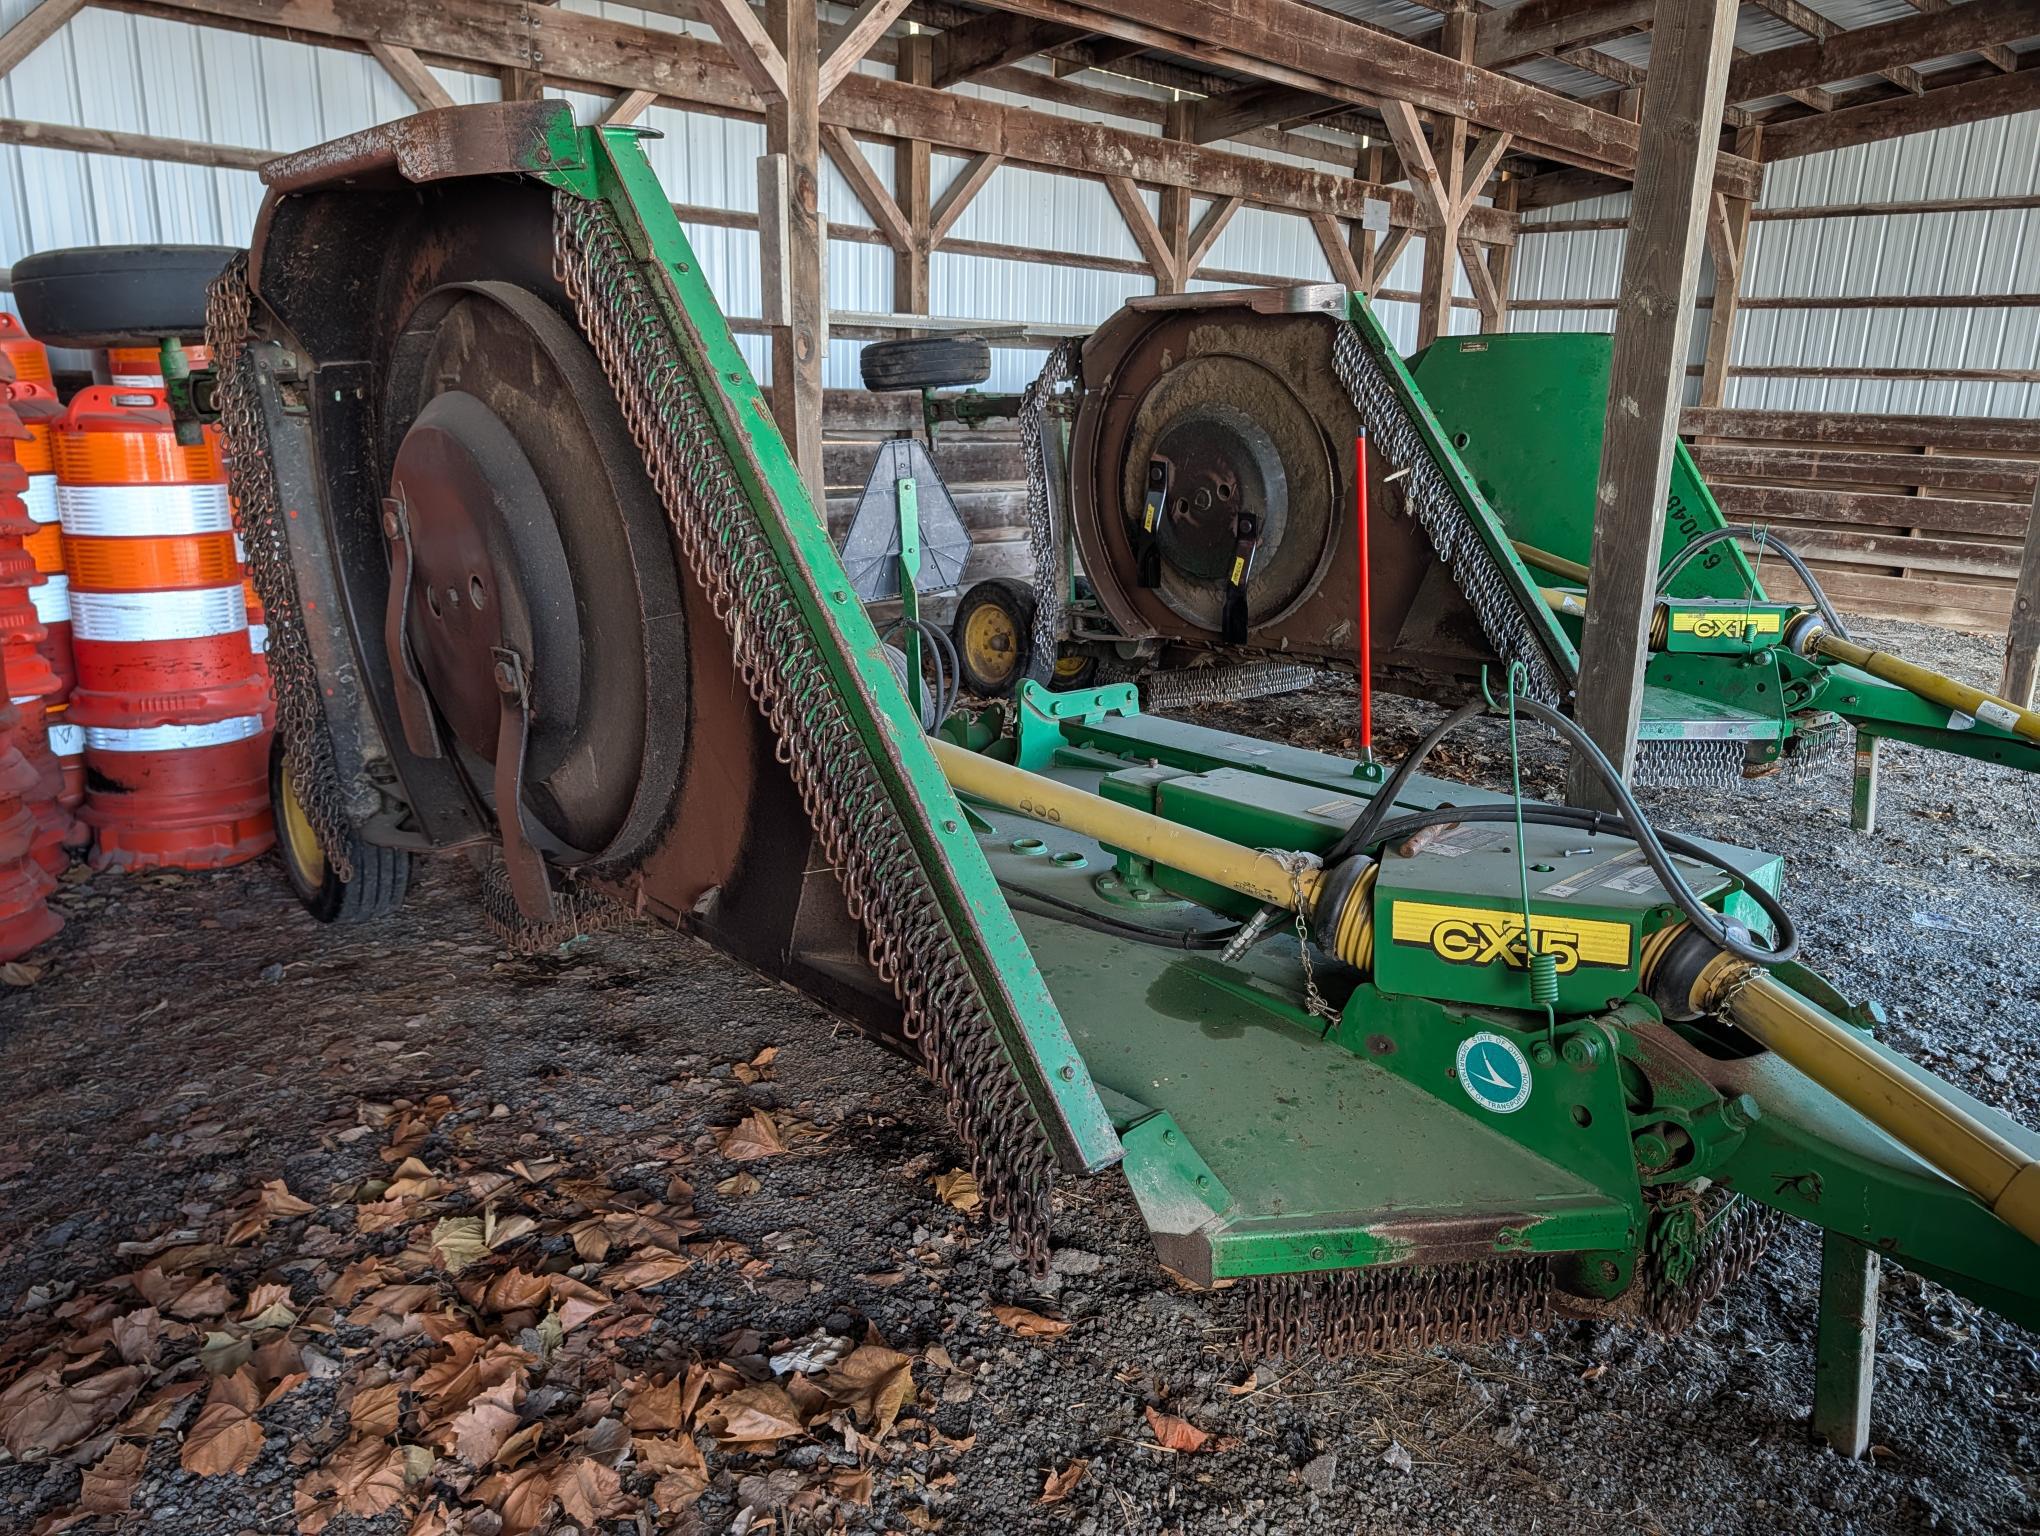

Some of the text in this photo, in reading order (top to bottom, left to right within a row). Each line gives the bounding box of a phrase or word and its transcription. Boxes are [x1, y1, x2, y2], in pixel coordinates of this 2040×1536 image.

[1431, 919, 1580, 977] CX15
[1459, 1045, 1529, 1109] DEPARTMENT OF TRANSPORTATION
[1472, 1035, 1523, 1065] STATE OF OHIO
